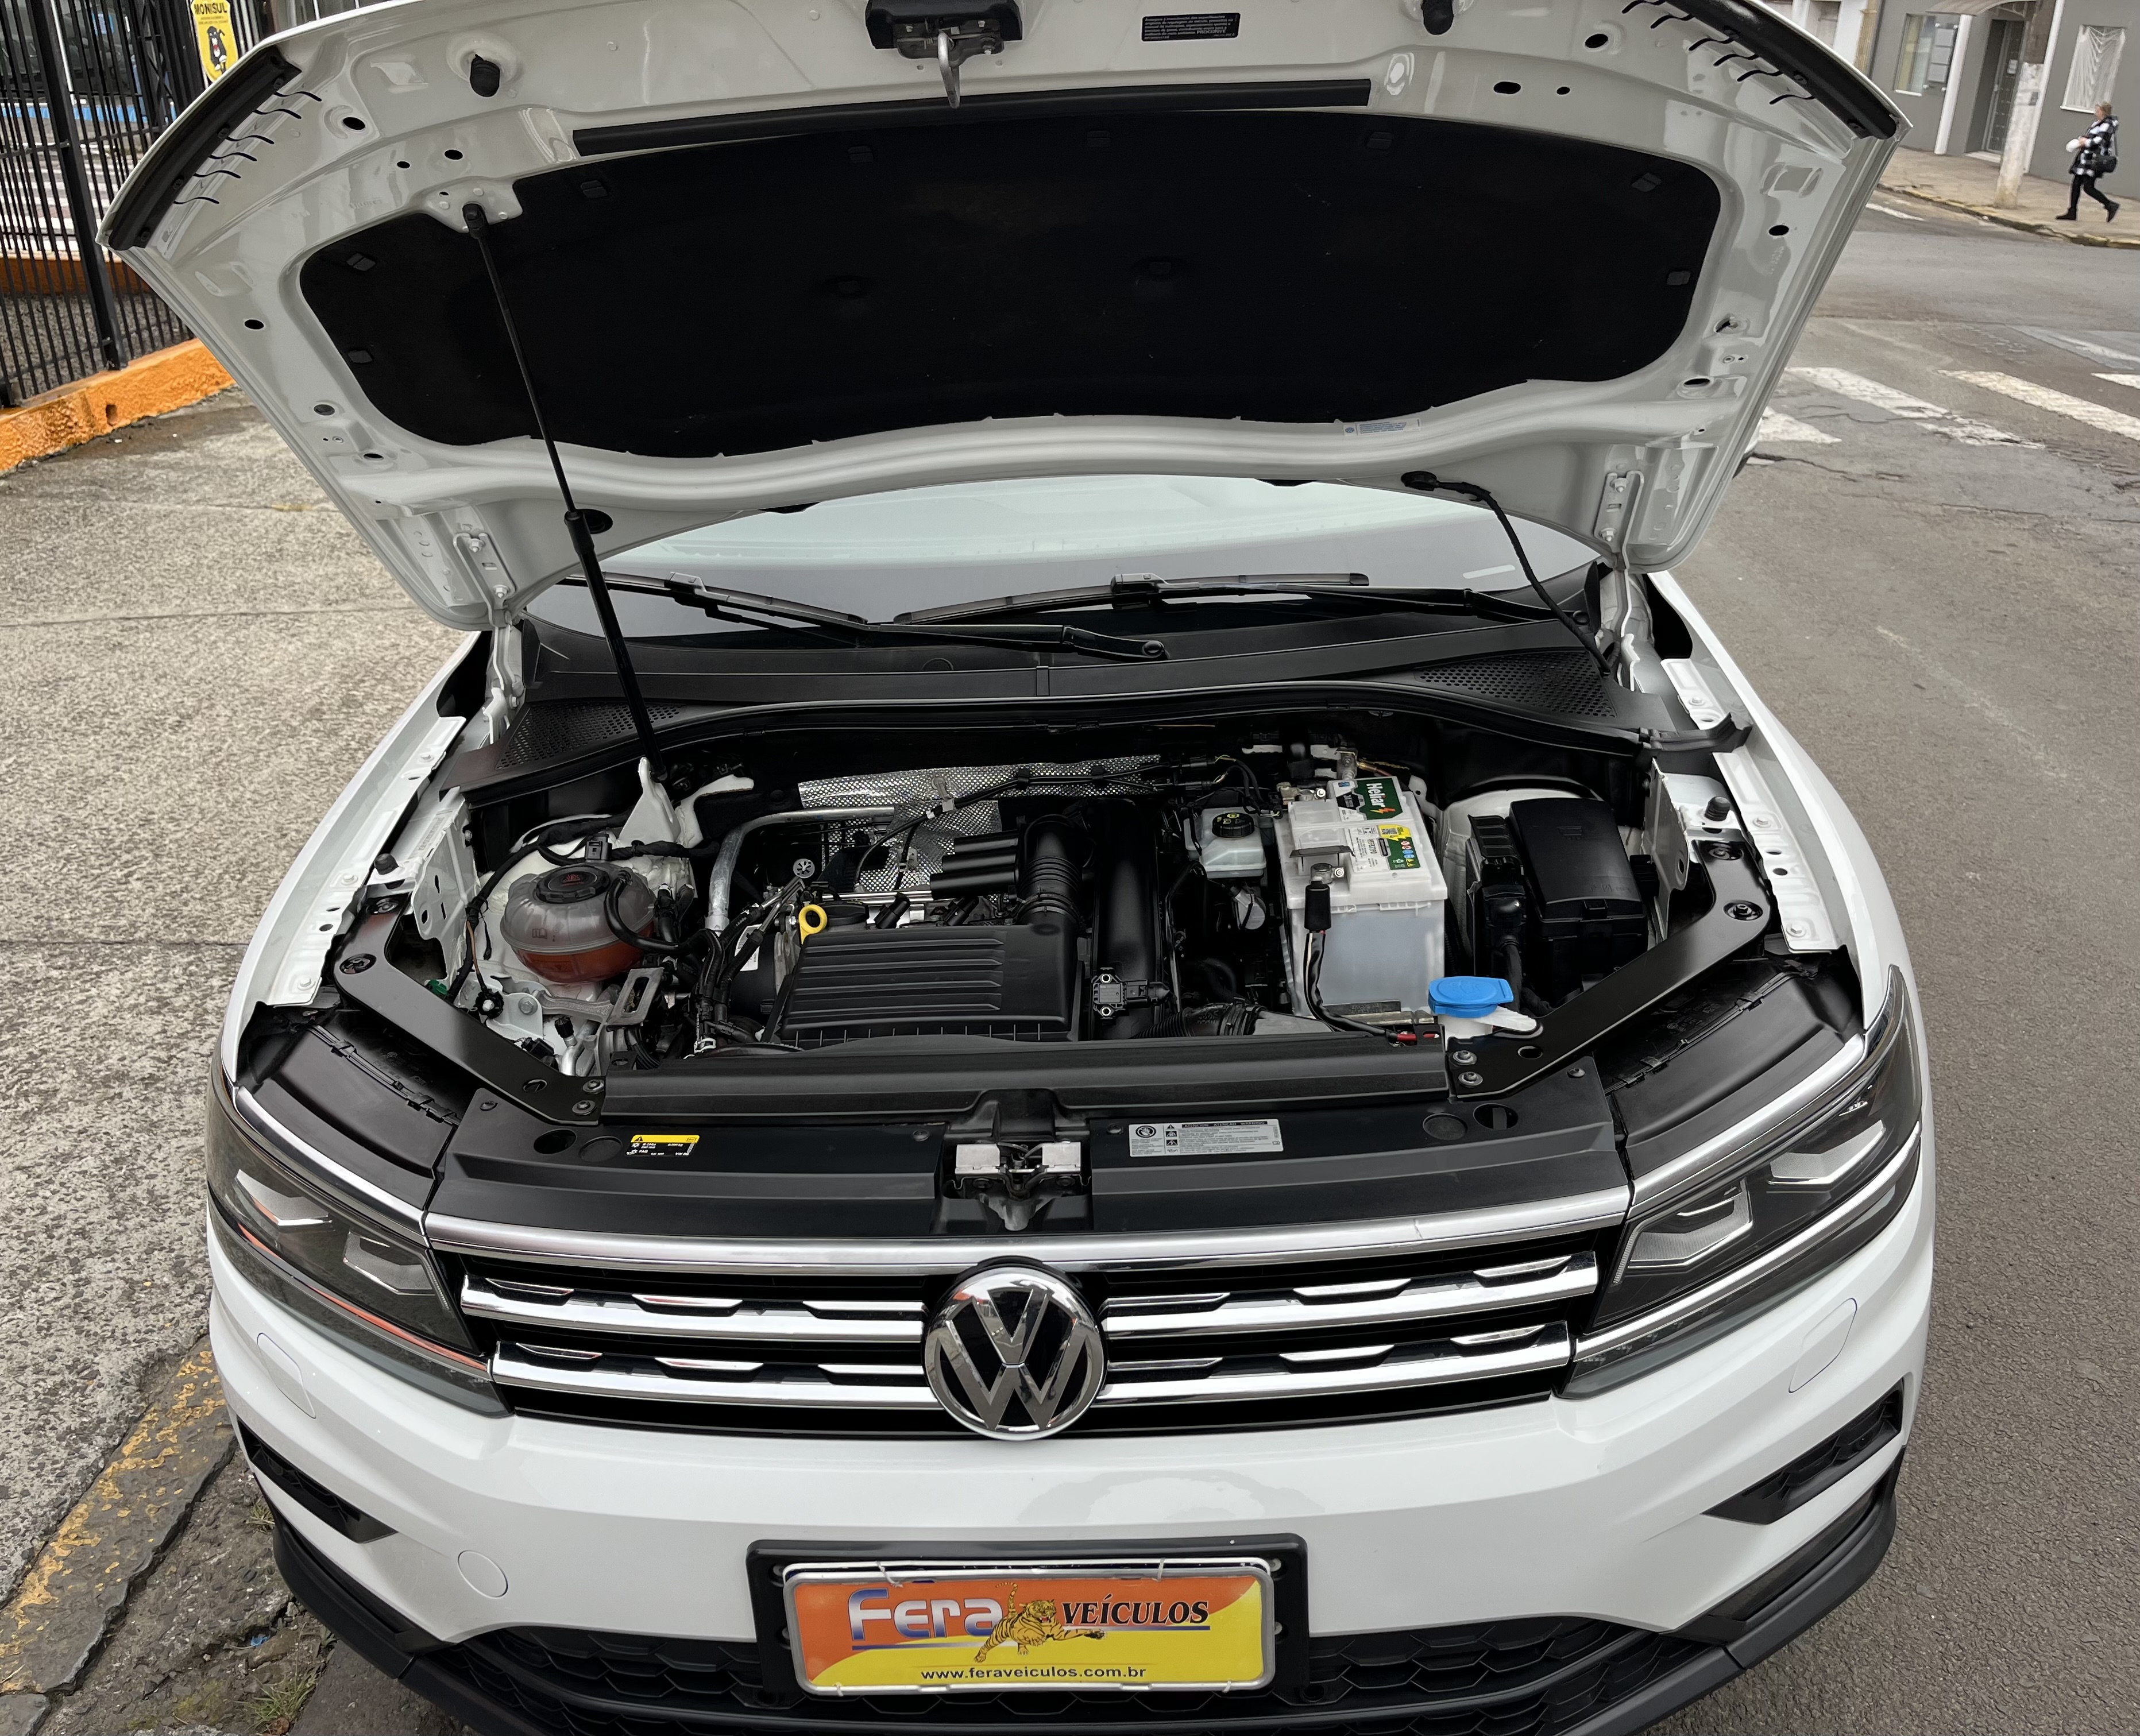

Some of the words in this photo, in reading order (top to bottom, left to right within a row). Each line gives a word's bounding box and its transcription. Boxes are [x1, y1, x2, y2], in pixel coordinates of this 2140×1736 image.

[194, 3, 227, 14] MONISUL
[1366, 783, 1386, 807] Heliar
[932, 1284, 1092, 1431] VW
[847, 1587, 1003, 1641] Fera
[1062, 1593, 1209, 1625] VEÍCULOS
[921, 1667, 1146, 1679] www.feraveiculos.com.br
